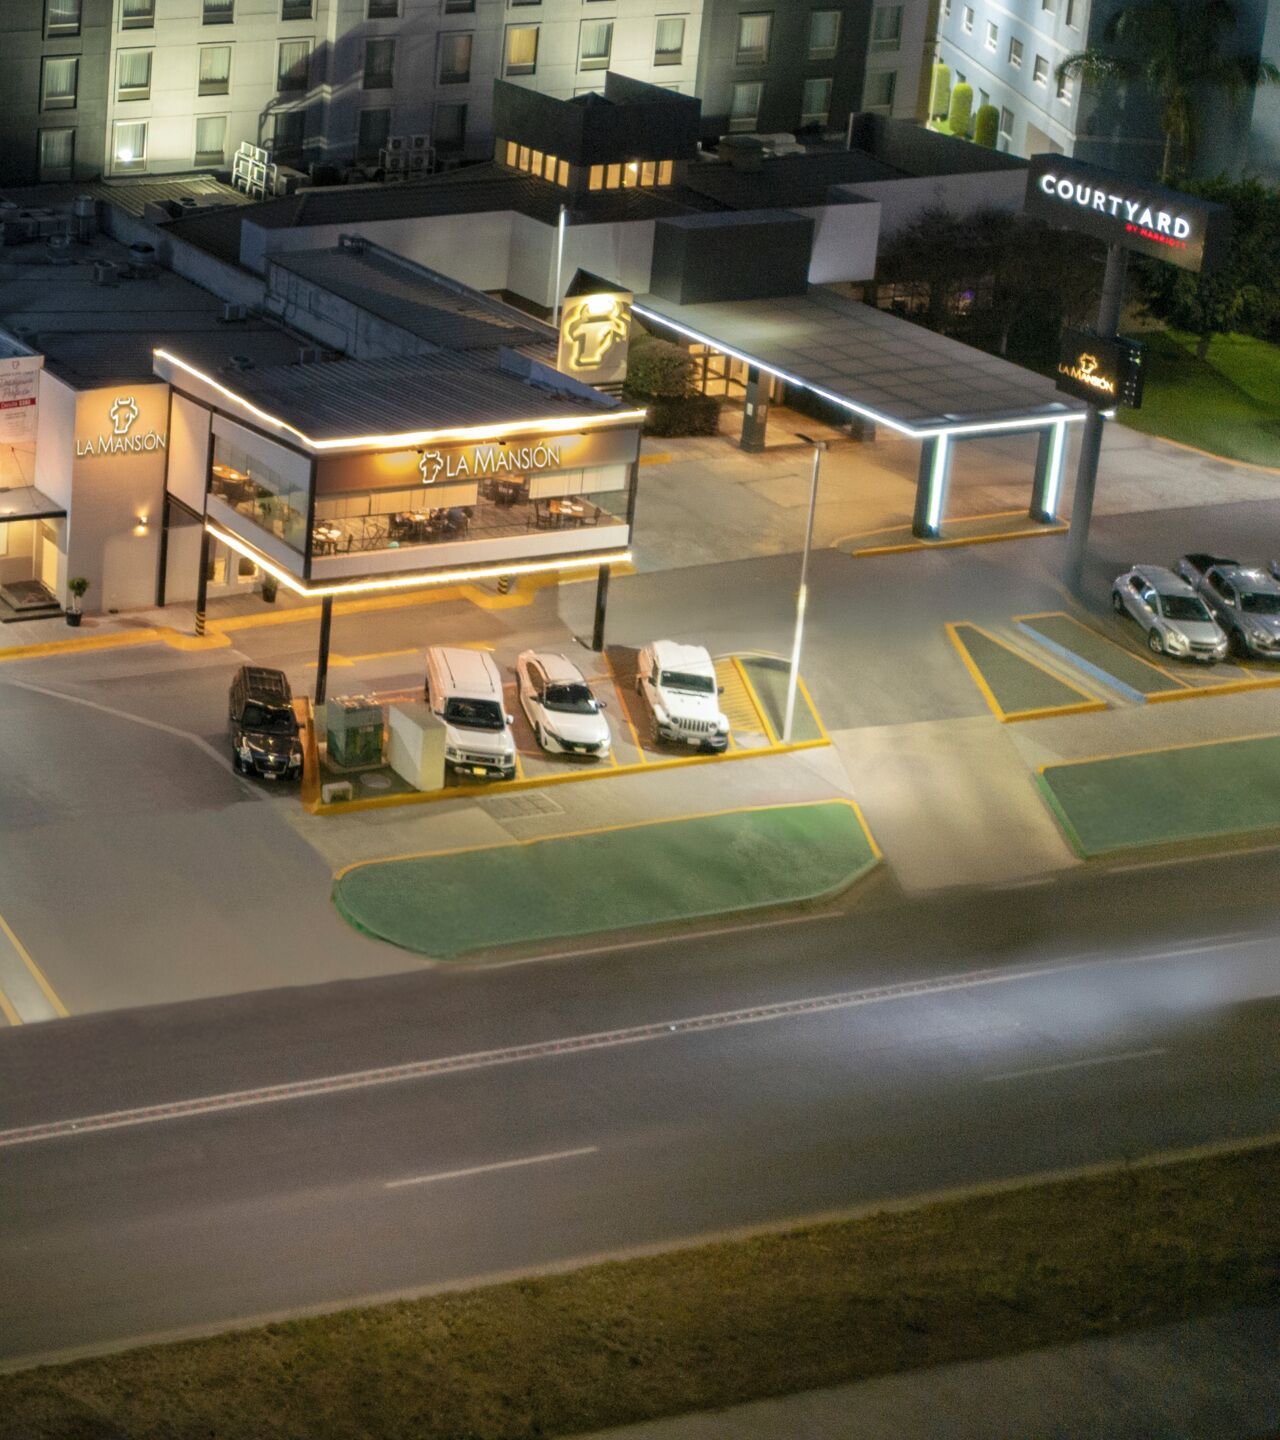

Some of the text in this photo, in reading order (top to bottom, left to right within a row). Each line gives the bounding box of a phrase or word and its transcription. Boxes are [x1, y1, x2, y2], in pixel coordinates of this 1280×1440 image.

[1041, 174, 1190, 239] COURTYARD
[1125, 223, 1187, 249] BY MARRIOTT
[1058, 362, 1070, 375] LA
[76, 430, 167, 456] LA MANSIÓN
[446, 441, 560, 477] LA MANSIÓN
